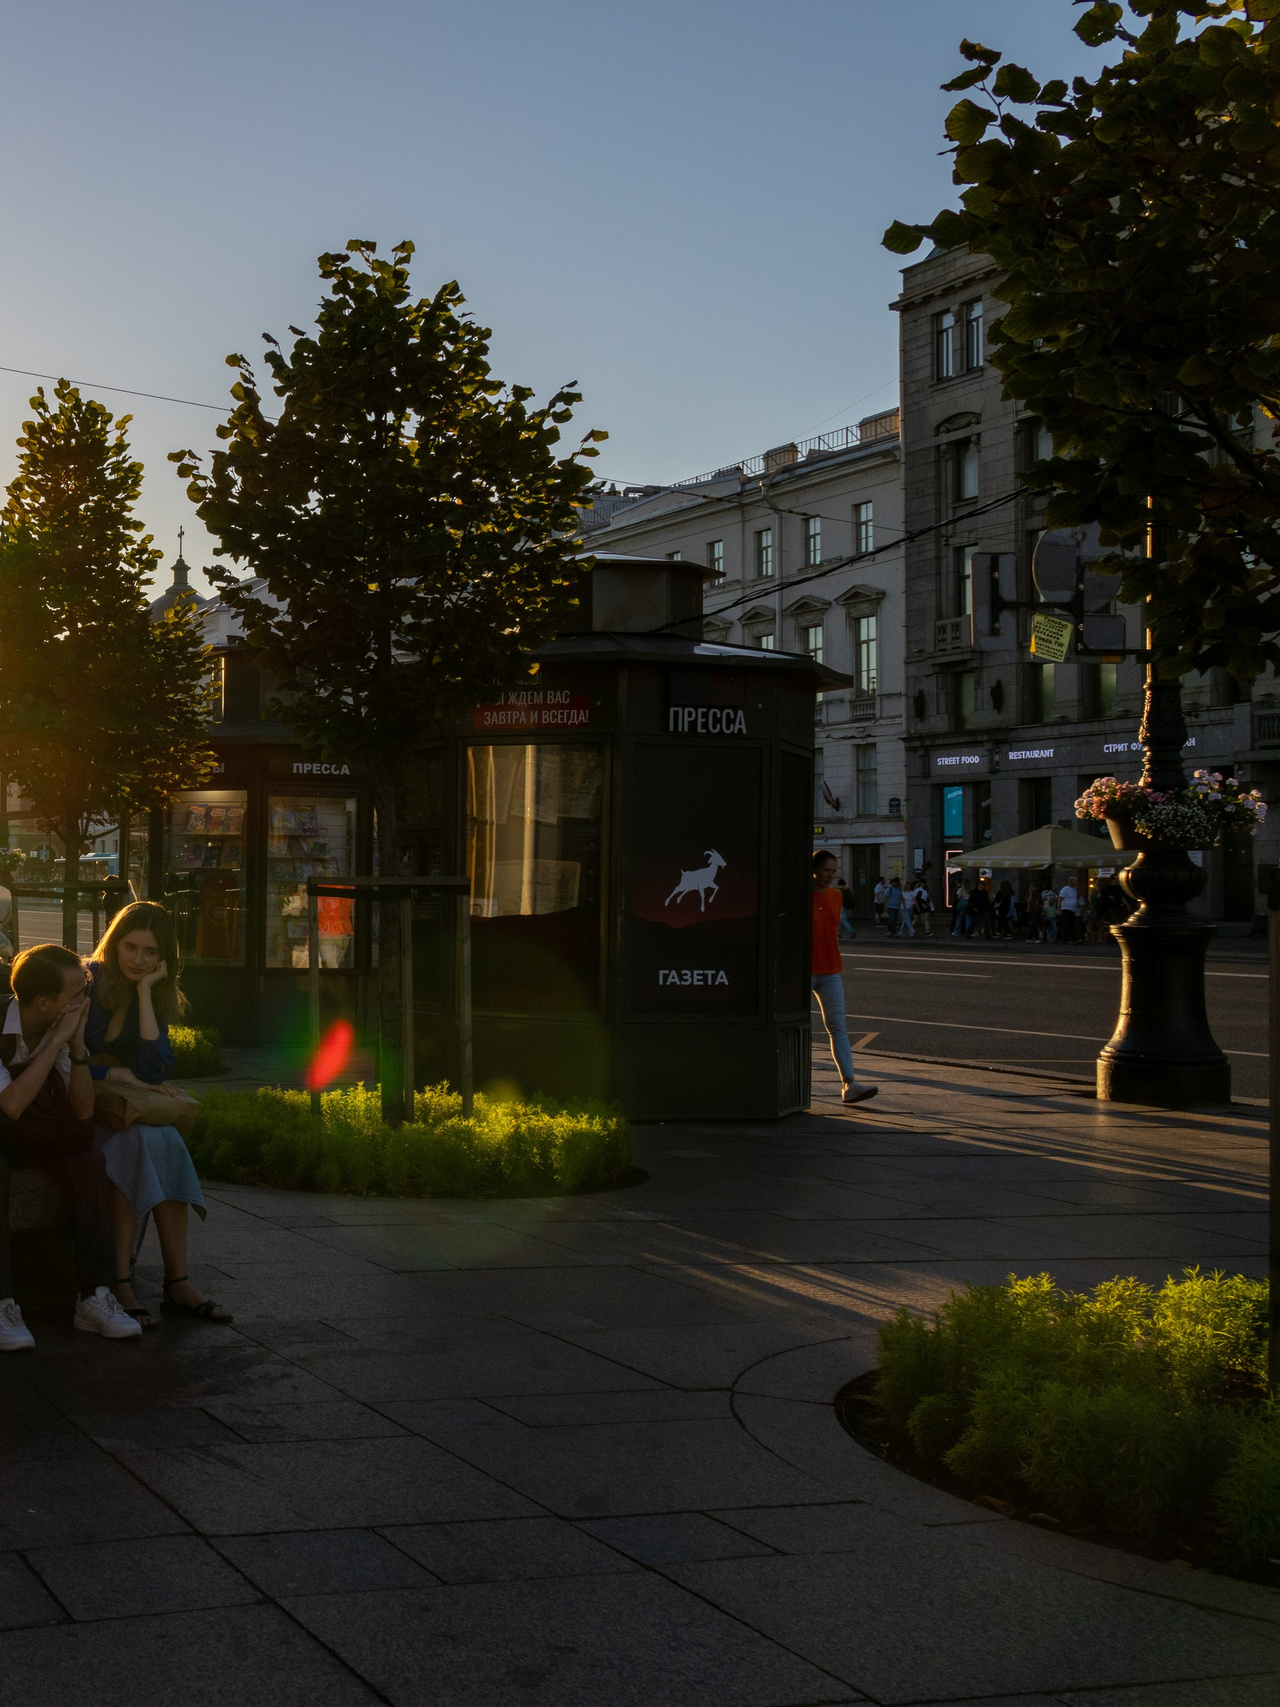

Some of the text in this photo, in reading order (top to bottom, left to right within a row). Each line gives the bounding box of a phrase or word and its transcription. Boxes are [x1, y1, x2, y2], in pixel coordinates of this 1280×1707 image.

[507, 690, 543, 706] ЖДЕМ
[547, 690, 570, 704] ВАС
[483, 709, 589, 725] ЗАВТРА И ВСЕГДА!
[669, 706, 747, 734] ПРЕССА
[1008, 749, 1055, 760] RESTAURANT
[1103, 742, 1129, 753] СТРИТ
[937, 755, 980, 766] STREET FOOD
[292, 762, 350, 775] ПРЕССА
[658, 969, 729, 986] ГАЗЕТА
